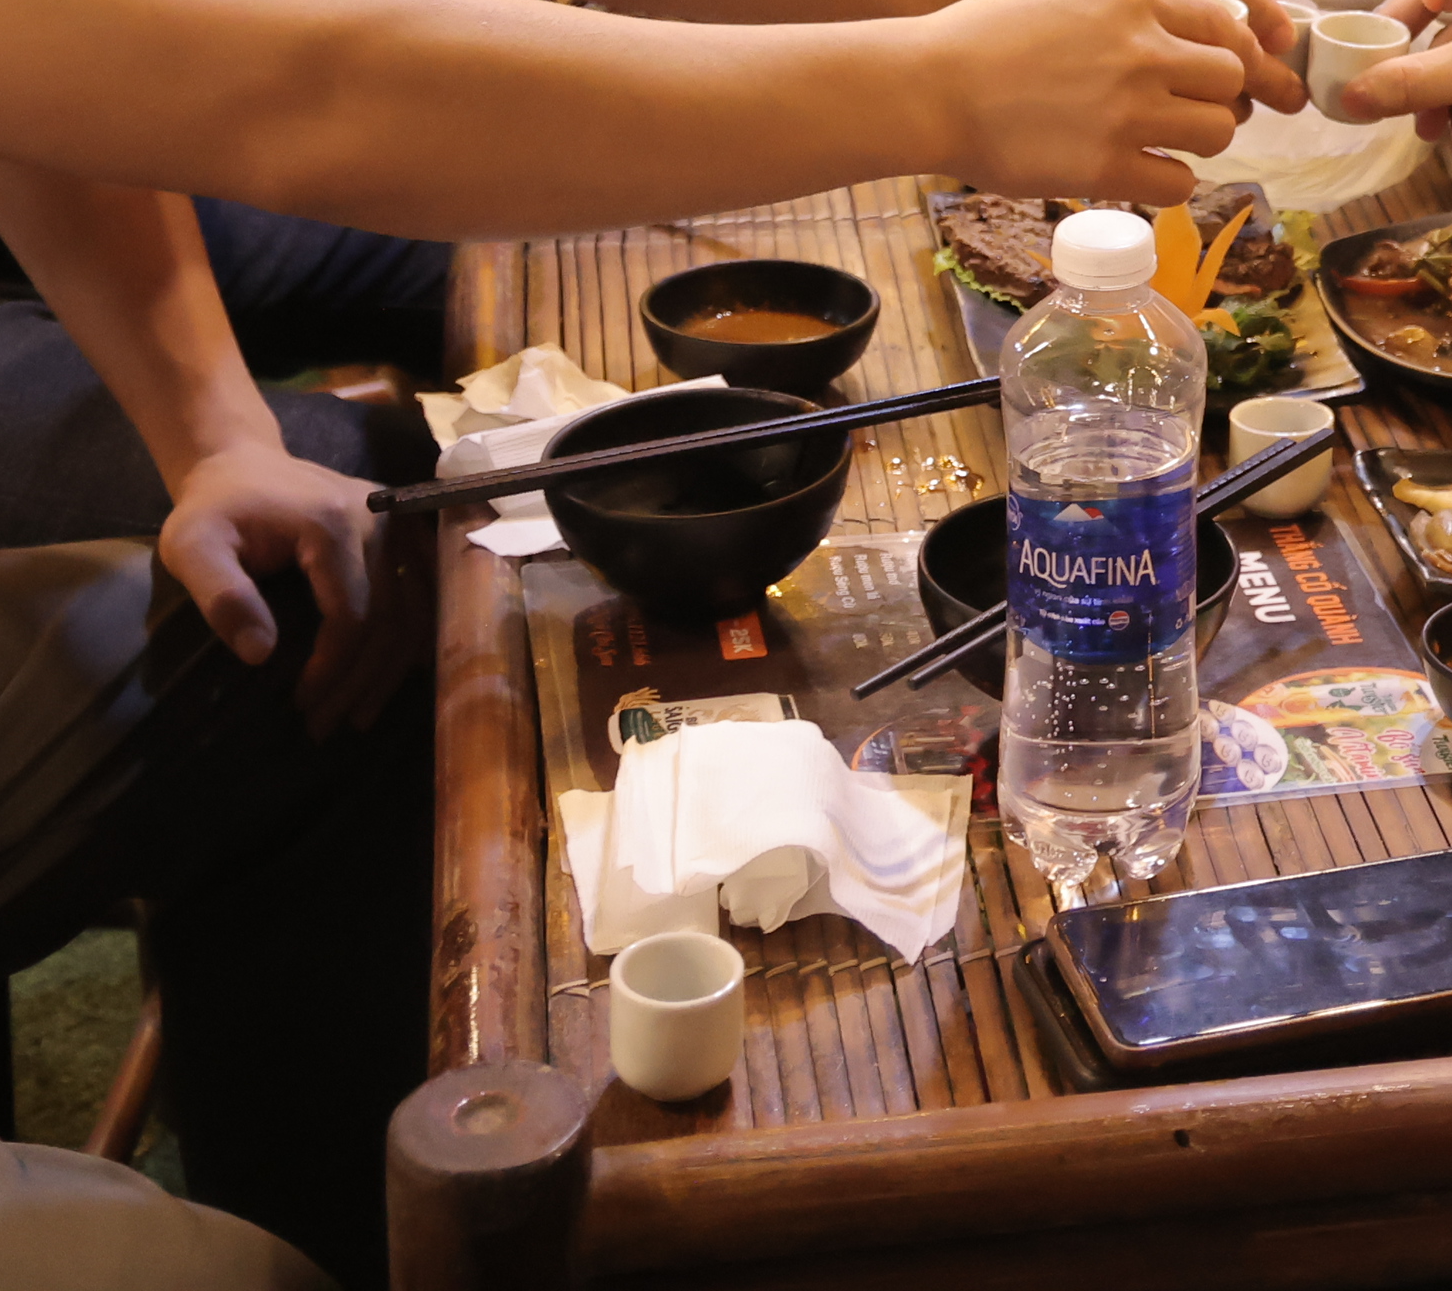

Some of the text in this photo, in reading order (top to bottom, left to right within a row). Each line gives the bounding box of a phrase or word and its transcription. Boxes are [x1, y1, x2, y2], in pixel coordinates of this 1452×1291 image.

[1019, 538, 1156, 589] AQUAFINA
[1268, 523, 1324, 571] THẮNG
[1238, 550, 1296, 625] MENU
[1295, 571, 1348, 593] CỐ
[729, 629, 754, 654] 25K
[664, 705, 683, 735] SAIG
